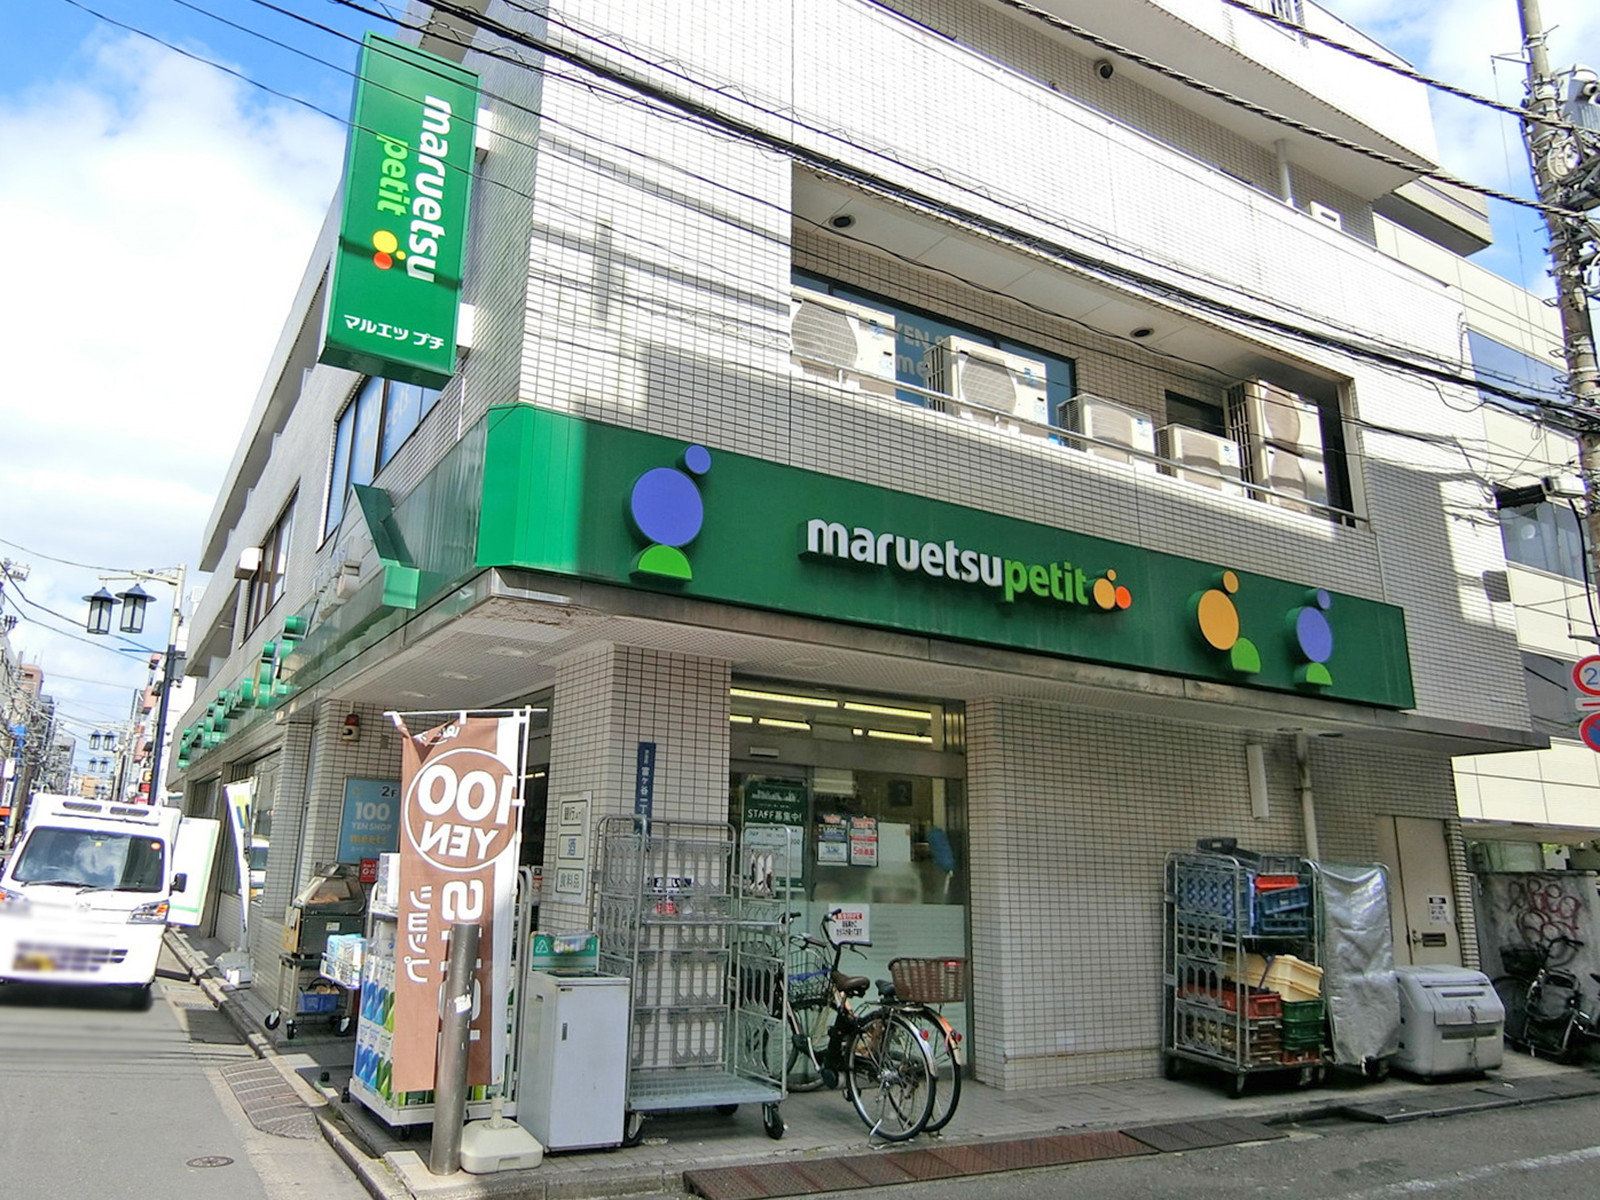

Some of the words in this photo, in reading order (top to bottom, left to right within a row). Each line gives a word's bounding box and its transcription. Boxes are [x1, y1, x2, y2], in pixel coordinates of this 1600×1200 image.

[375, 133, 411, 217] petit
[405, 93, 453, 284] maruetsu
[343, 313, 410, 342] マルエツ
[412, 331, 446, 351] プチ
[1583, 667, 1600, 685] 2
[381, 786, 398, 798] 2F
[355, 801, 391, 821] 100
[351, 821, 369, 831] YEN
[369, 822, 392, 832] SHOP
